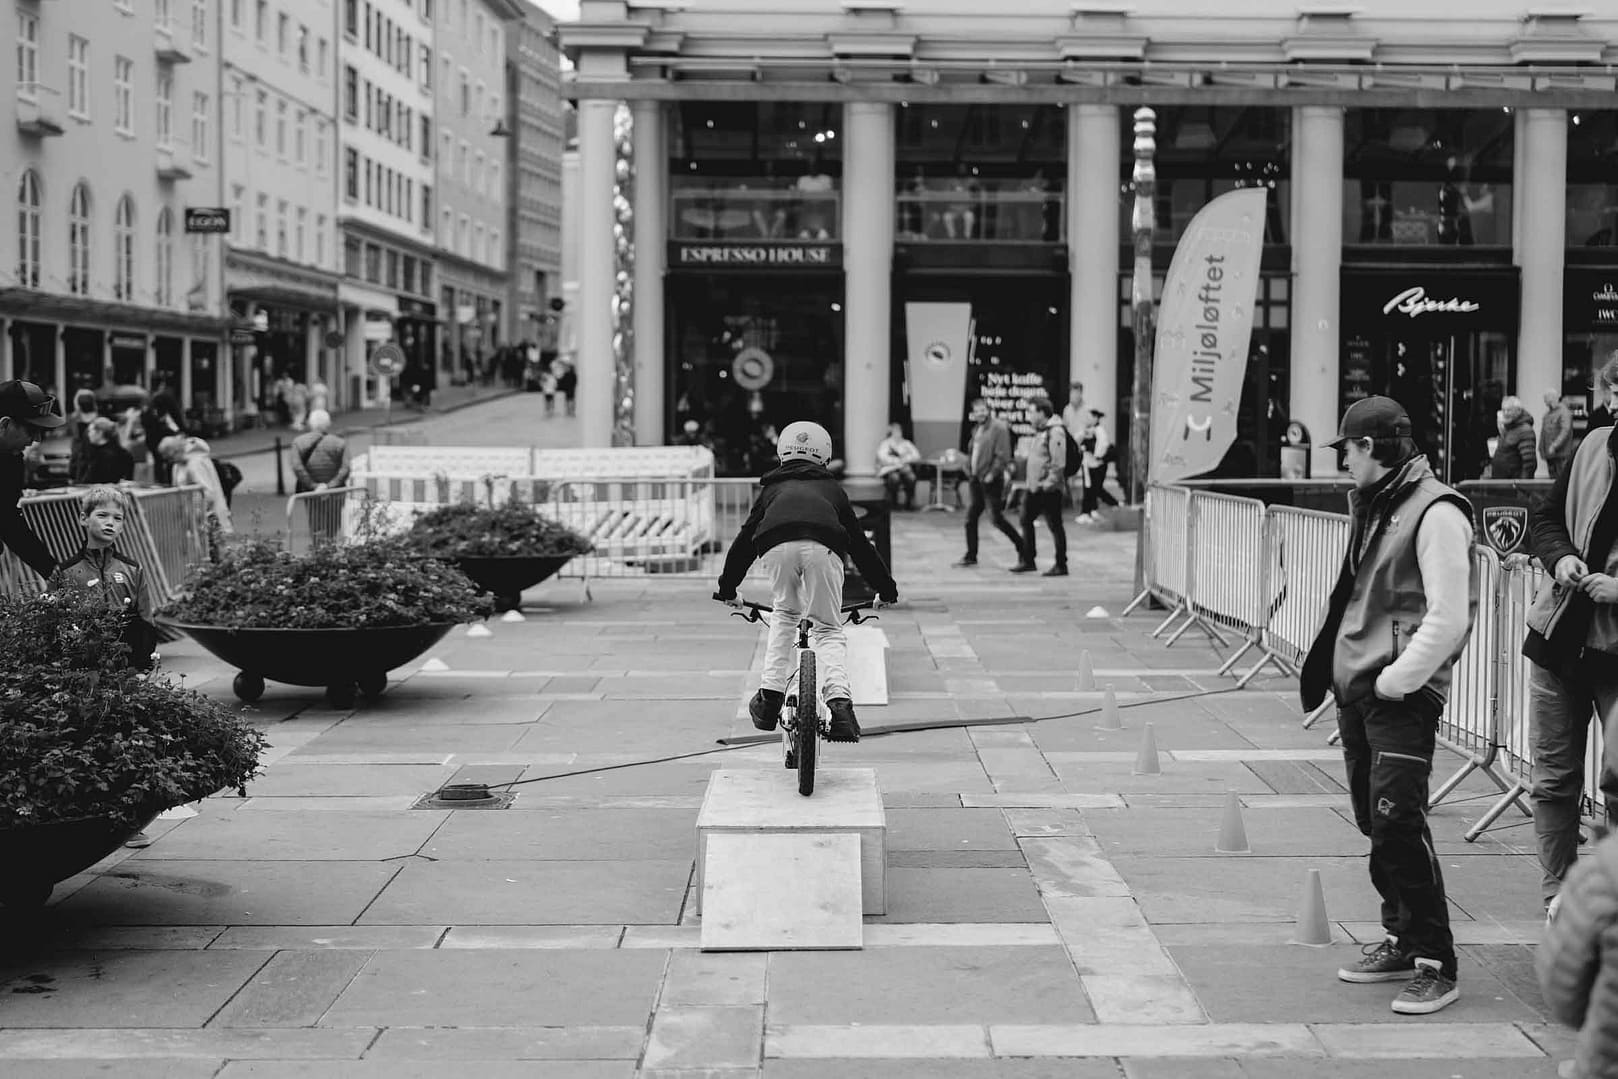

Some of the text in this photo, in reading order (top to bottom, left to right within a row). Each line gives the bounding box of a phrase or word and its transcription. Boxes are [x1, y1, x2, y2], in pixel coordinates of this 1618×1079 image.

[680, 247, 831, 262] ESPRESSO HOUSE
[1383, 286, 1480, 318] Bjerke
[1188, 253, 1225, 403] Miljøløftet
